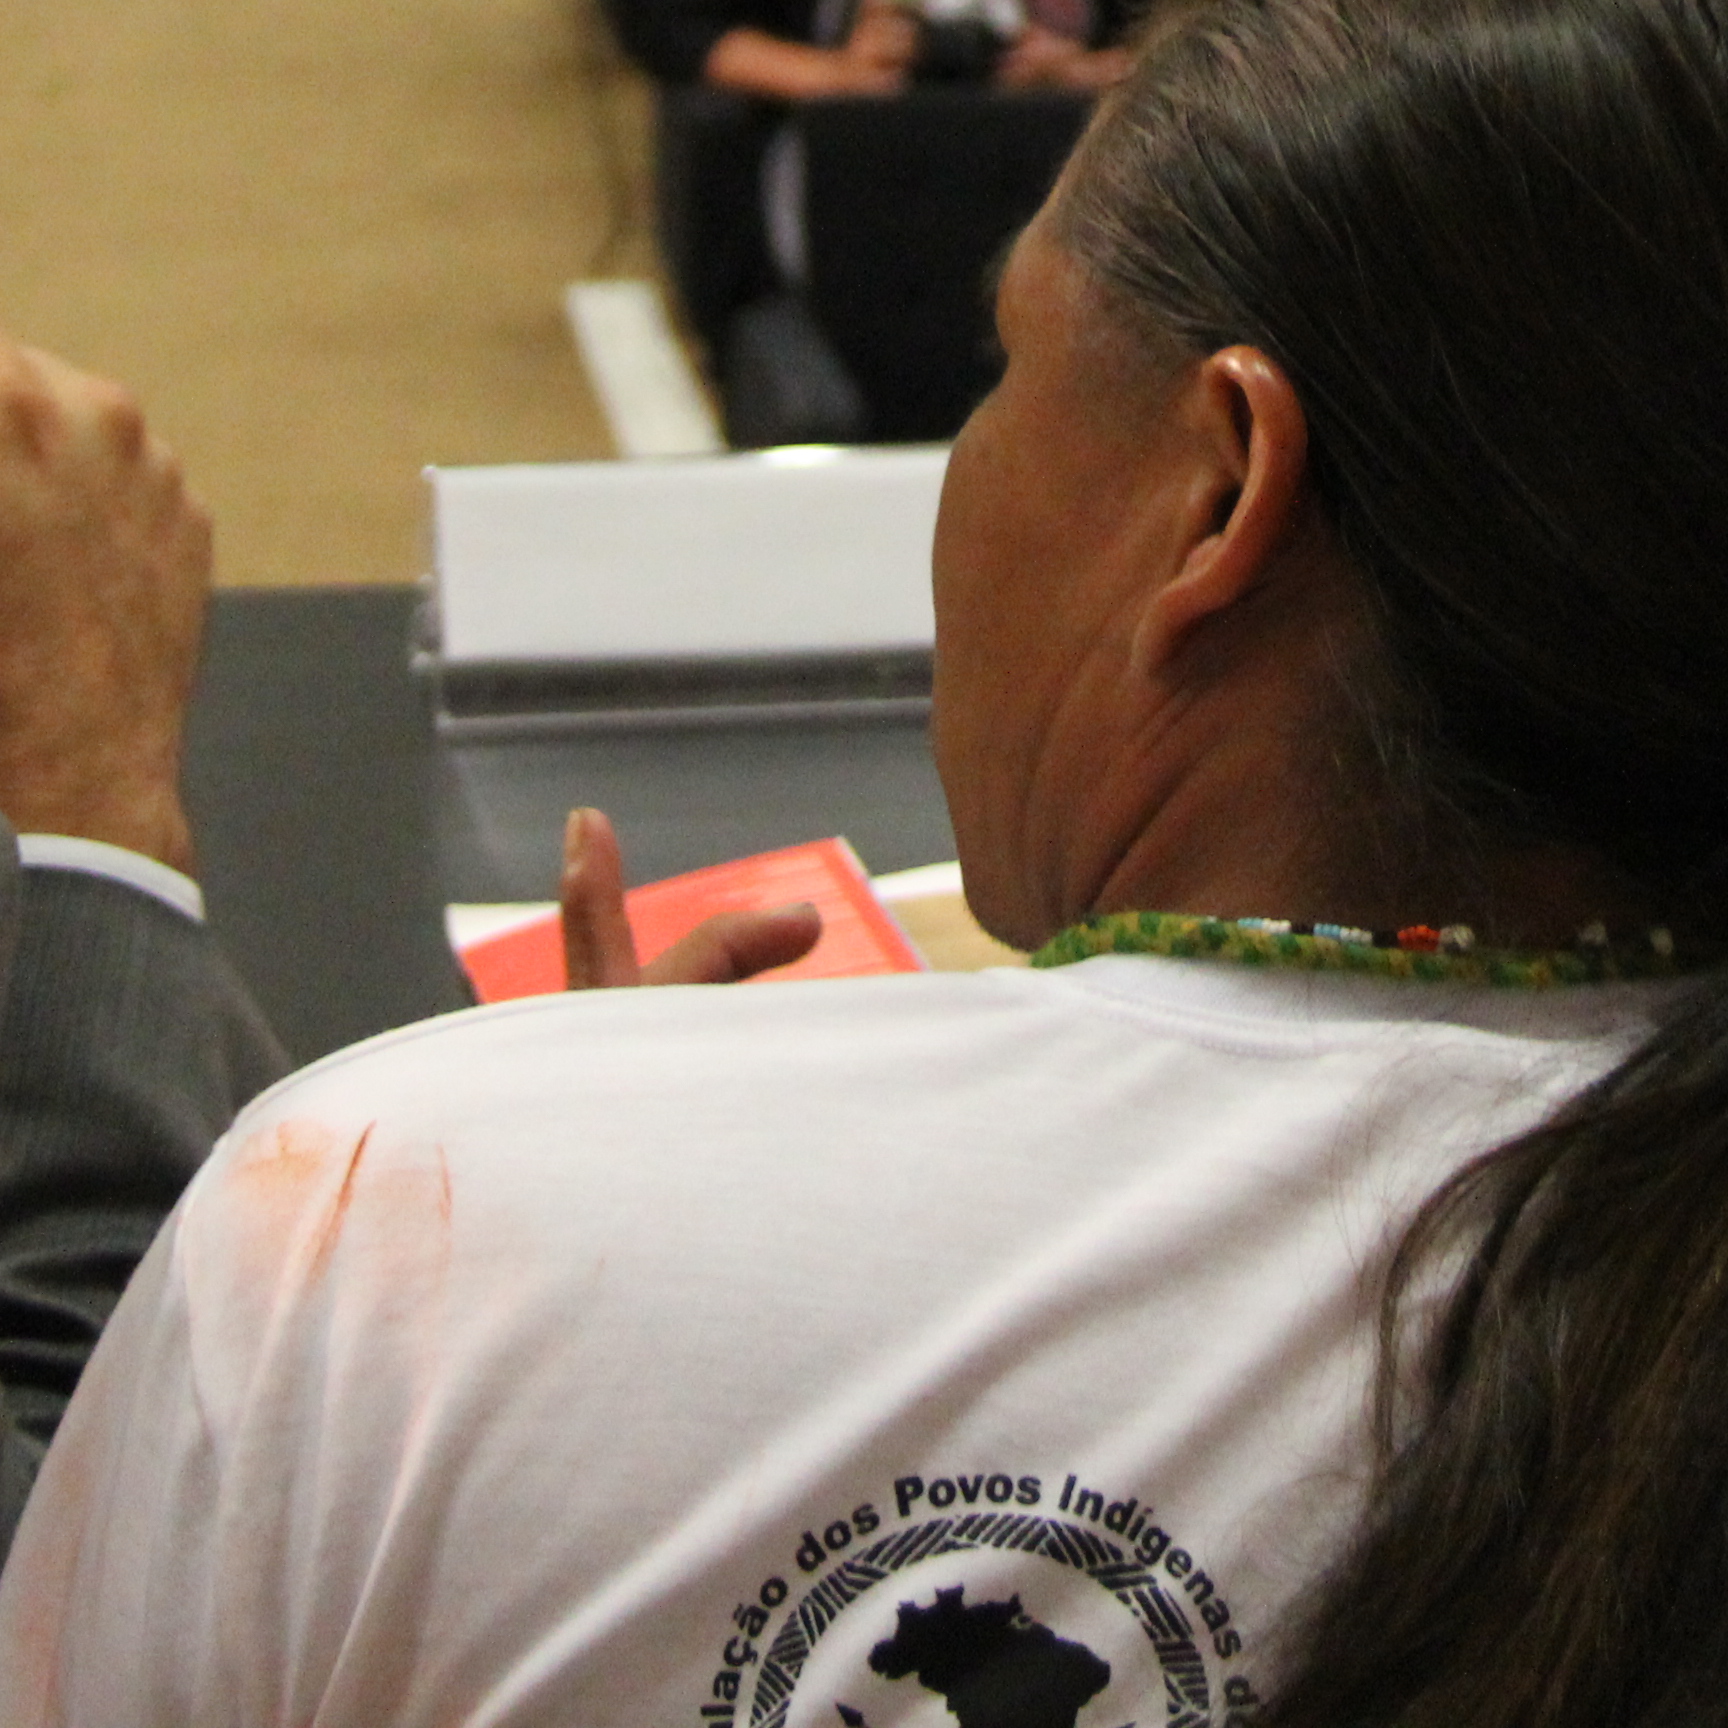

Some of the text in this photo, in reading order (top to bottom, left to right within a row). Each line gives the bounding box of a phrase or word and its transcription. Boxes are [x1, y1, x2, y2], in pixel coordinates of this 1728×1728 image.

[699, 1576, 789, 1728] lação
[795, 1502, 881, 1572] dos
[893, 1473, 1042, 1518] Povos
[1057, 1473, 1242, 1660] Indígenas
